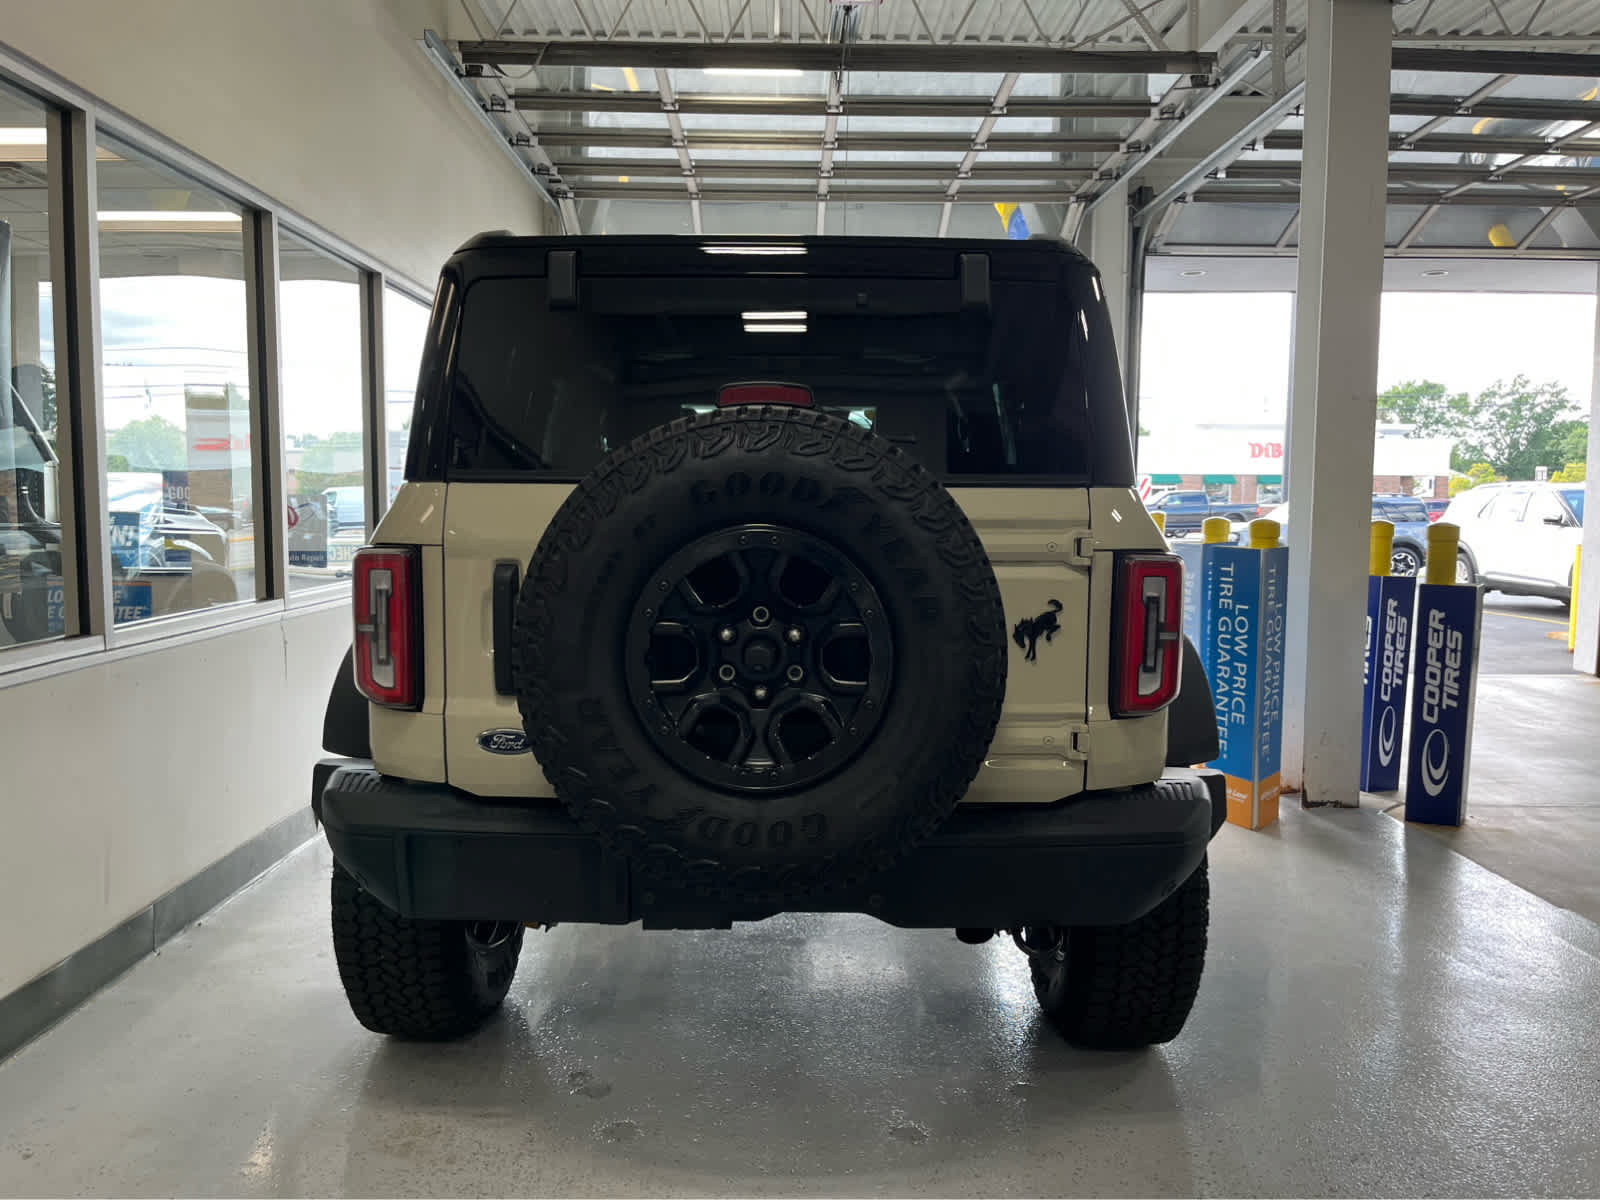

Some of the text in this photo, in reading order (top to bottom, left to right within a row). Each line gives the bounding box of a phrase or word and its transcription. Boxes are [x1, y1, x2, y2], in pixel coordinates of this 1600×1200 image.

[1219, 562, 1234, 610] TIRE
[1266, 565, 1277, 607] TIRE
[1231, 604, 1249, 725] LOW PRICE
[1271, 603, 1283, 722] LOW PRICE
[1380, 598, 1398, 702] COOPER
[1392, 615, 1408, 688] TIRES
[1422, 608, 1446, 724] COOPER
[1442, 629, 1463, 710] TIRES
[490, 734, 525, 749] Ford
